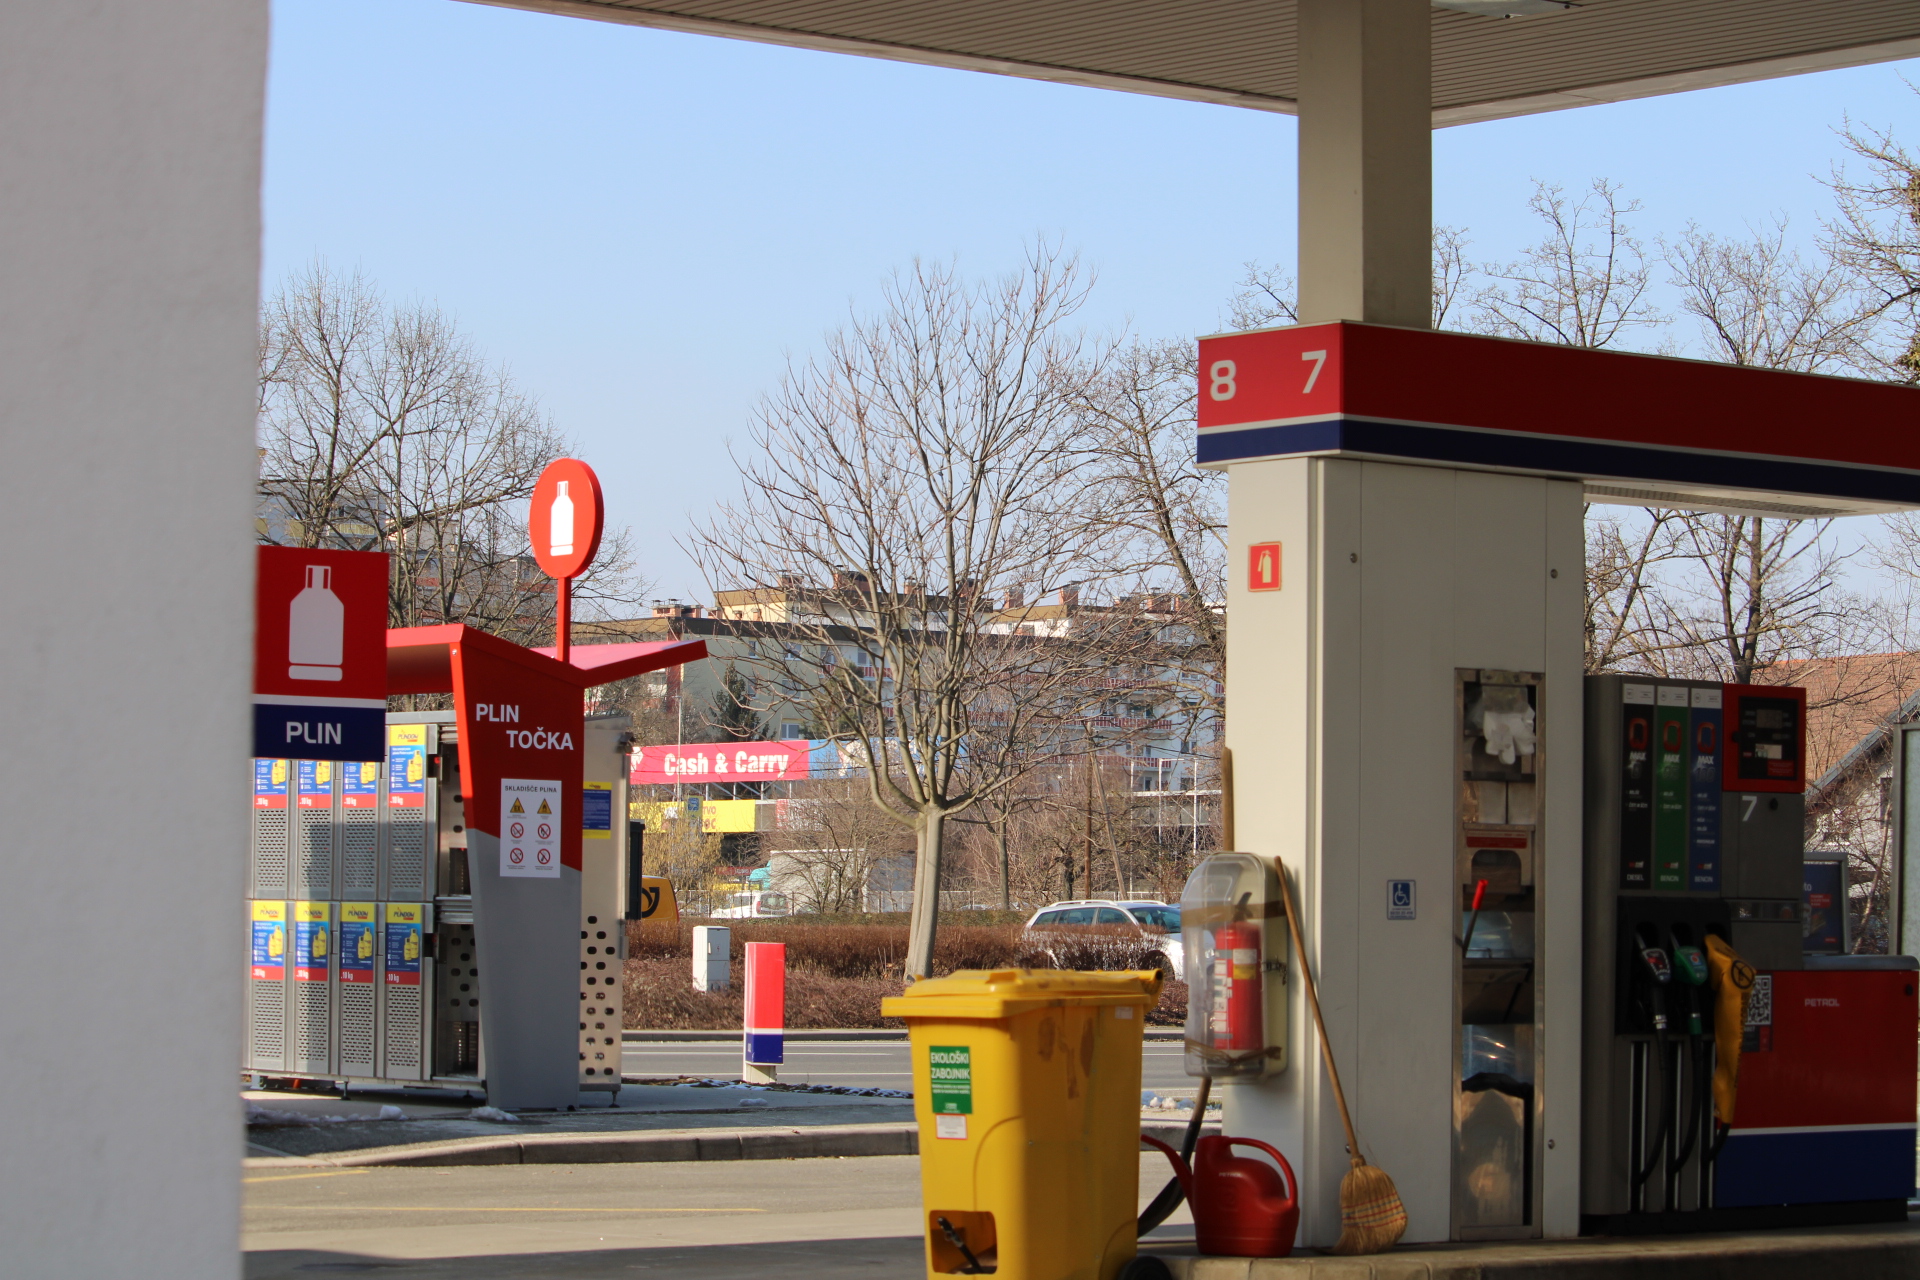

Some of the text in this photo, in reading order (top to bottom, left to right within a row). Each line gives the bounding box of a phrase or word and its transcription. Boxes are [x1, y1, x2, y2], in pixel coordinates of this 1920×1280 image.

[1210, 349, 1327, 402] 8 7
[475, 703, 520, 723] PLIN
[286, 721, 342, 745] PLIN
[506, 726, 574, 751] TOČKA
[664, 751, 789, 778] Cash & Carry
[1697, 755, 1715, 765] MAX
[504, 784, 538, 792] SKLADIŠČE
[1741, 795, 1758, 822] 7
[1627, 873, 1645, 881] DIESEL
[1804, 997, 1840, 1007] PETROL
[930, 1050, 969, 1064] EKOLOŠKI
[930, 1067, 970, 1079] ZABOJNIK
